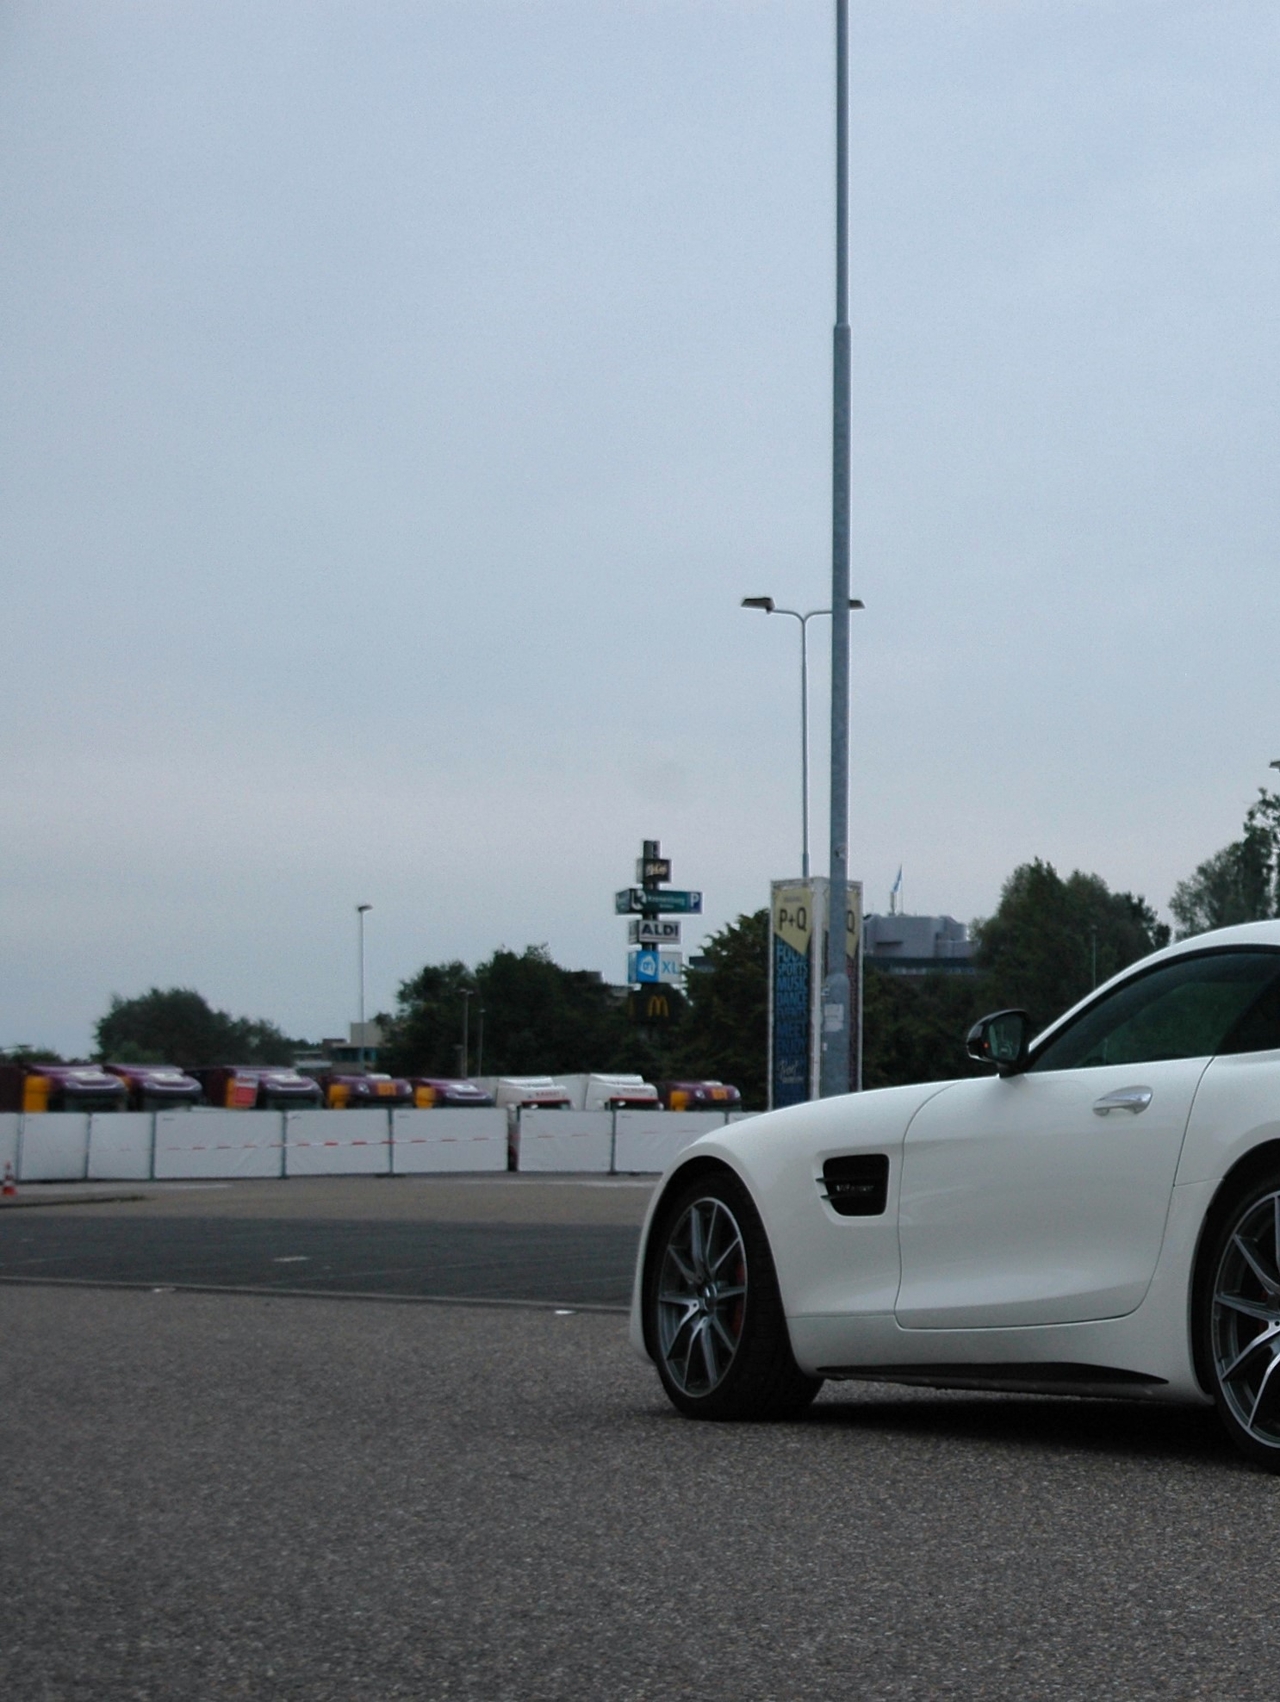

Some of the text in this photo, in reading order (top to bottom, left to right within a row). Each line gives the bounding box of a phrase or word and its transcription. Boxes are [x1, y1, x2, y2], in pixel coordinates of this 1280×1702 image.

[690, 893, 699, 908] P
[779, 907, 807, 932] P+Q
[642, 923, 679, 937] ALDI
[662, 961, 680, 975] XL
[777, 976, 808, 991] MUSIC
